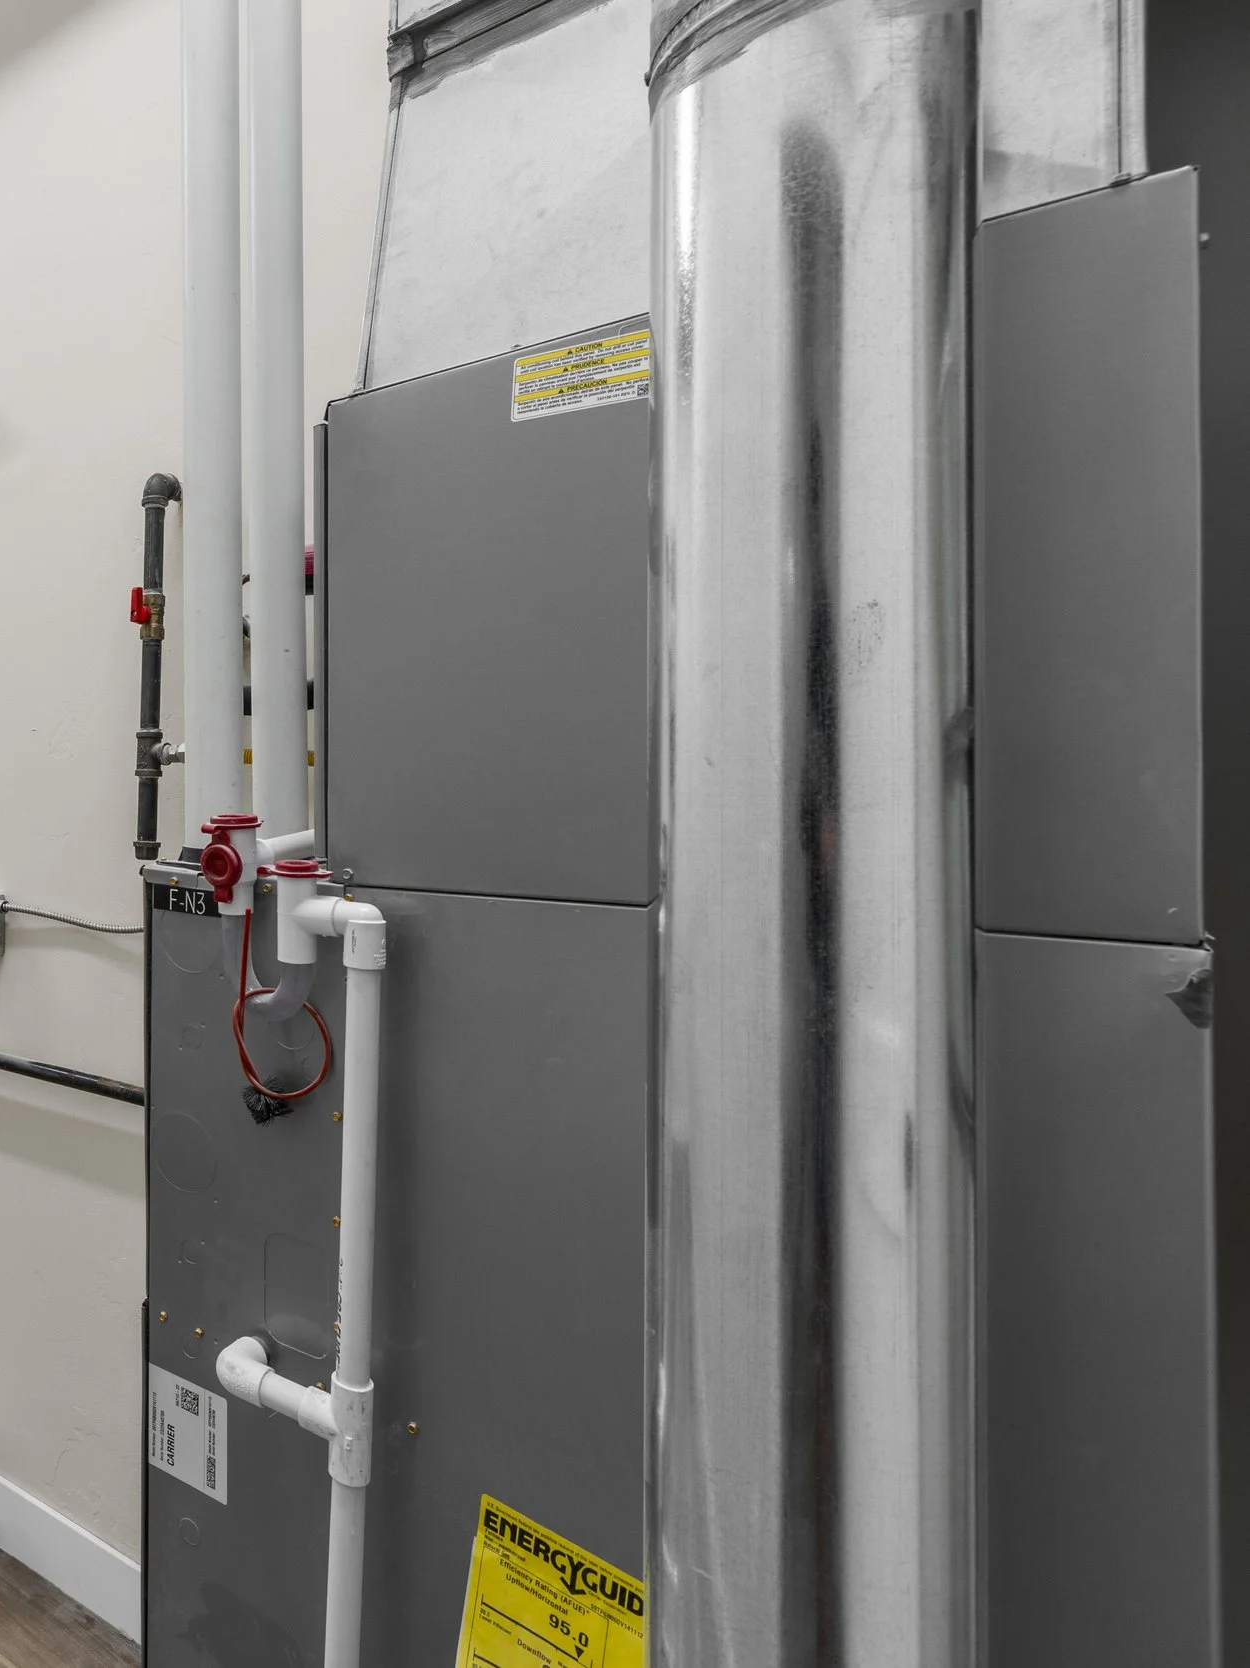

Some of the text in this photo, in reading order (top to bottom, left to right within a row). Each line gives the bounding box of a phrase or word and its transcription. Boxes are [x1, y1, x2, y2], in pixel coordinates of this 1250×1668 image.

[575, 342, 602, 353] CAUTION
[571, 359, 605, 371] PRUDENCE
[567, 379, 607, 392] PRECAUCIÓN
[170, 888, 205, 915] F-N3
[485, 1528, 504, 1543] Furnace
[484, 1509, 643, 1616] ENERGYGUID
[499, 1559, 534, 1583] Efficiency
[535, 1580, 558, 1599] Rating
[505, 1575, 568, 1615] Upflow/Horizontal
[549, 1613, 589, 1648] 95.0
[517, 1638, 552, 1664] Downflow
